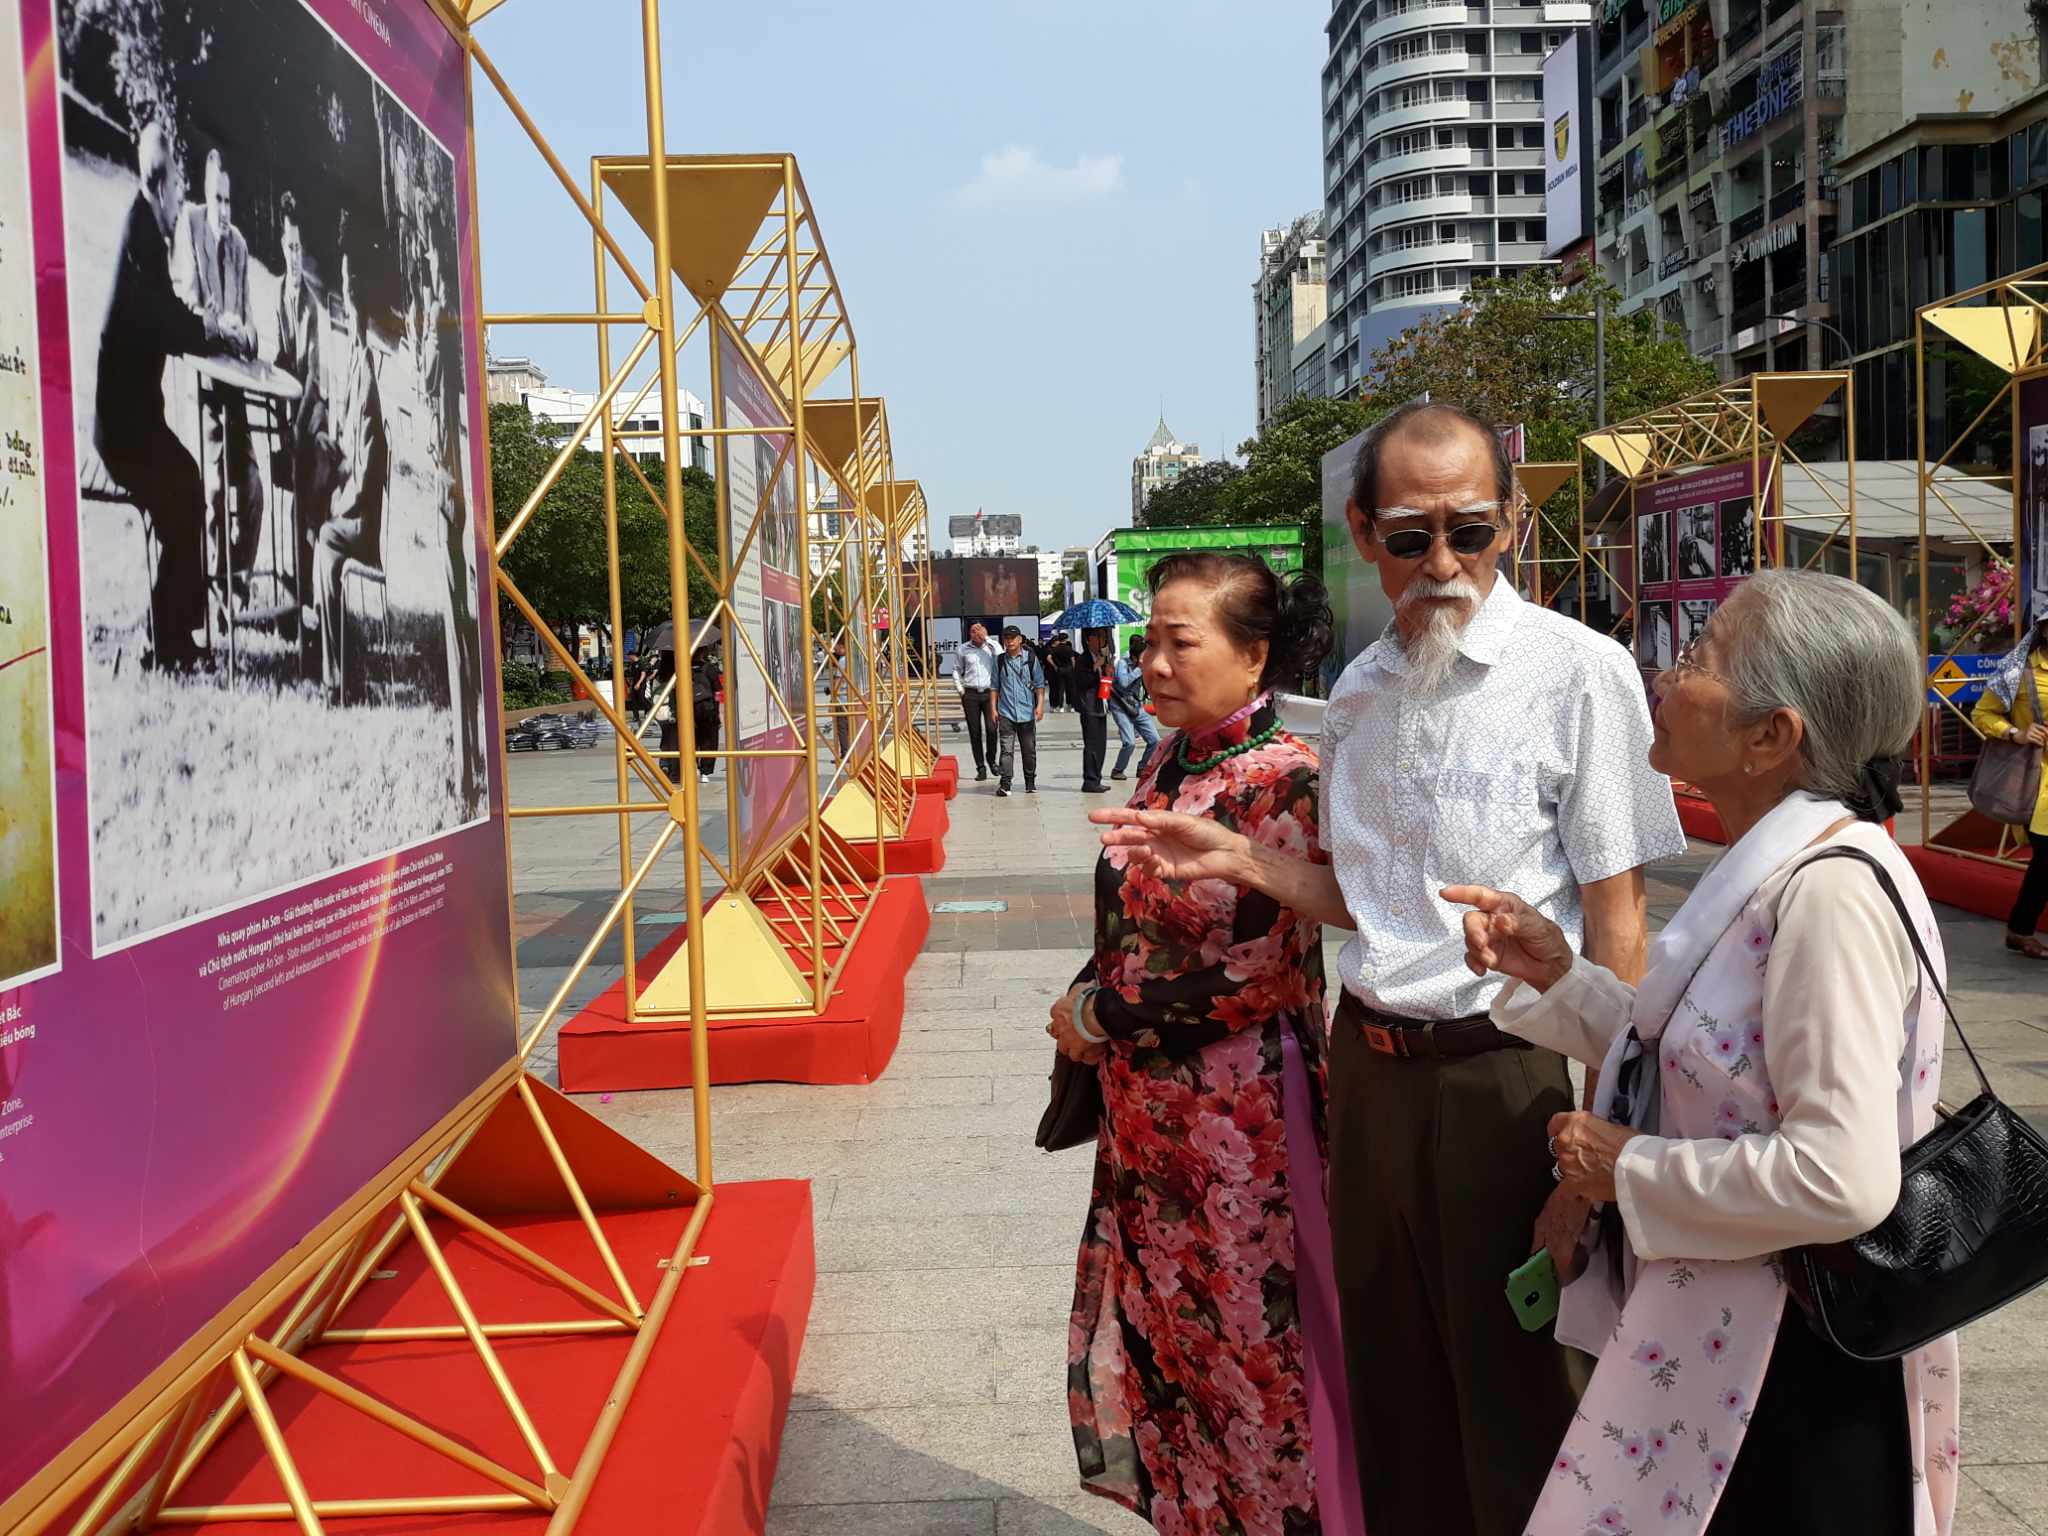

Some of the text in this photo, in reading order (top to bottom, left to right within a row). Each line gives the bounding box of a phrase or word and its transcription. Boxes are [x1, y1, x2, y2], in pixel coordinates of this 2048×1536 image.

[363, 1, 391, 48] CINEMA
[231, 927, 246, 944] quay
[246, 920, 261, 939] phim
[248, 939, 273, 956] Hungary
[218, 961, 266, 991] Cinematographer
[230, 987, 253, 1008] Hungary
[14, 1024, 36, 1043] bóng
[0, 1114, 33, 1140] nterprise
